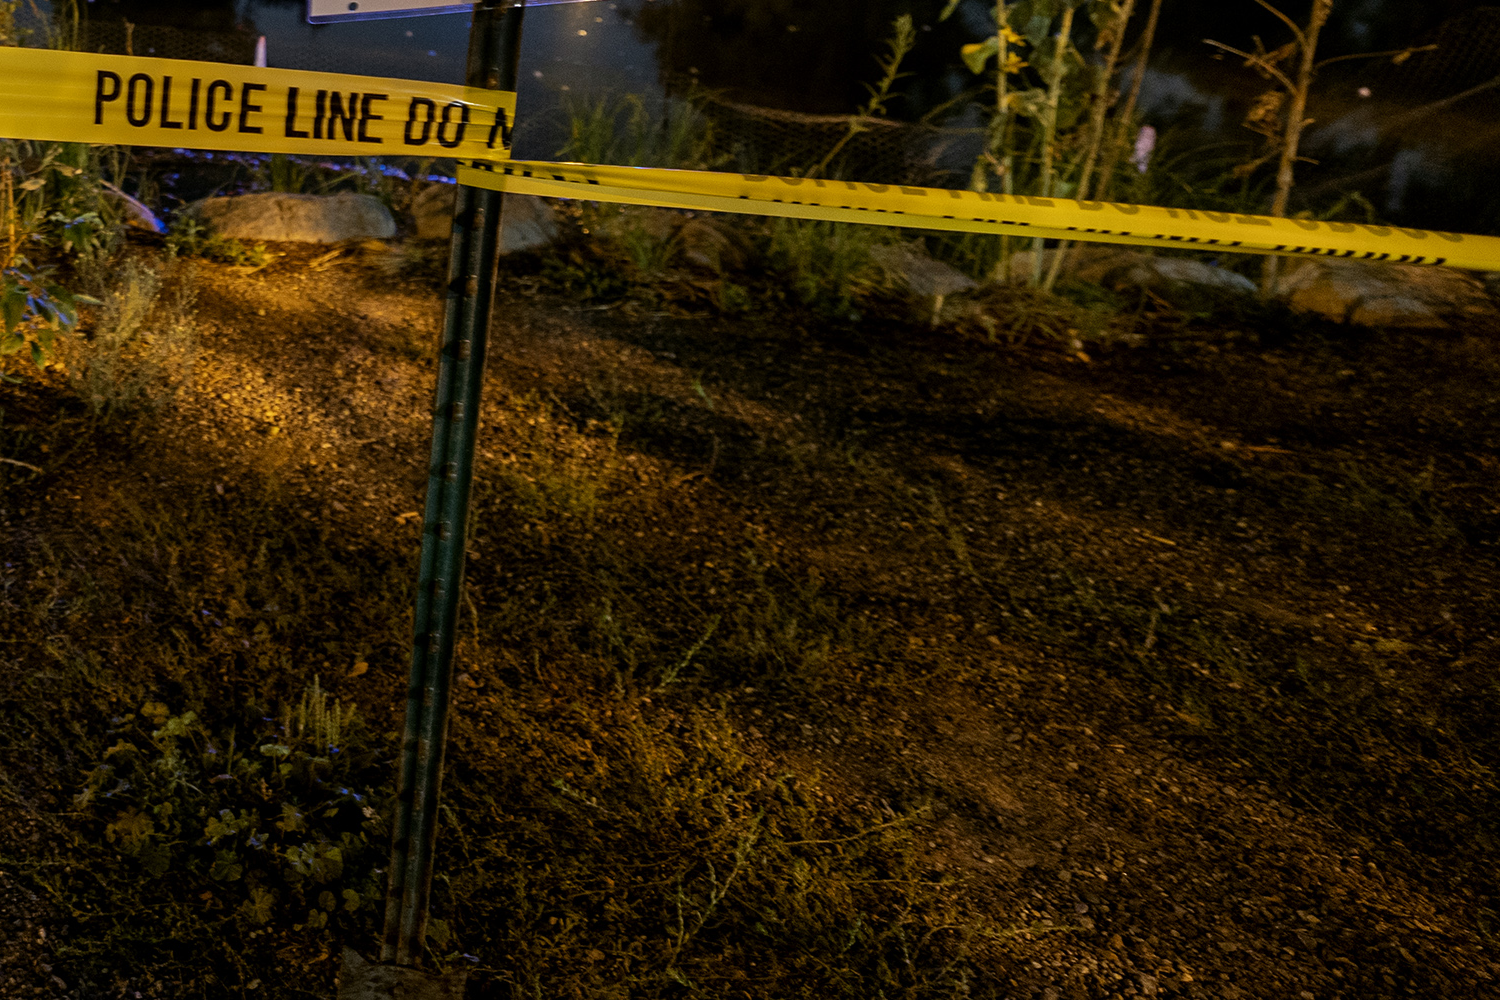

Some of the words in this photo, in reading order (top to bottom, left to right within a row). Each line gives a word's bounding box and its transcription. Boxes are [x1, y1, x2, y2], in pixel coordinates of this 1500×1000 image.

[95, 69, 267, 134] POLICE
[284, 86, 390, 144] LINE
[404, 97, 470, 148] DO
